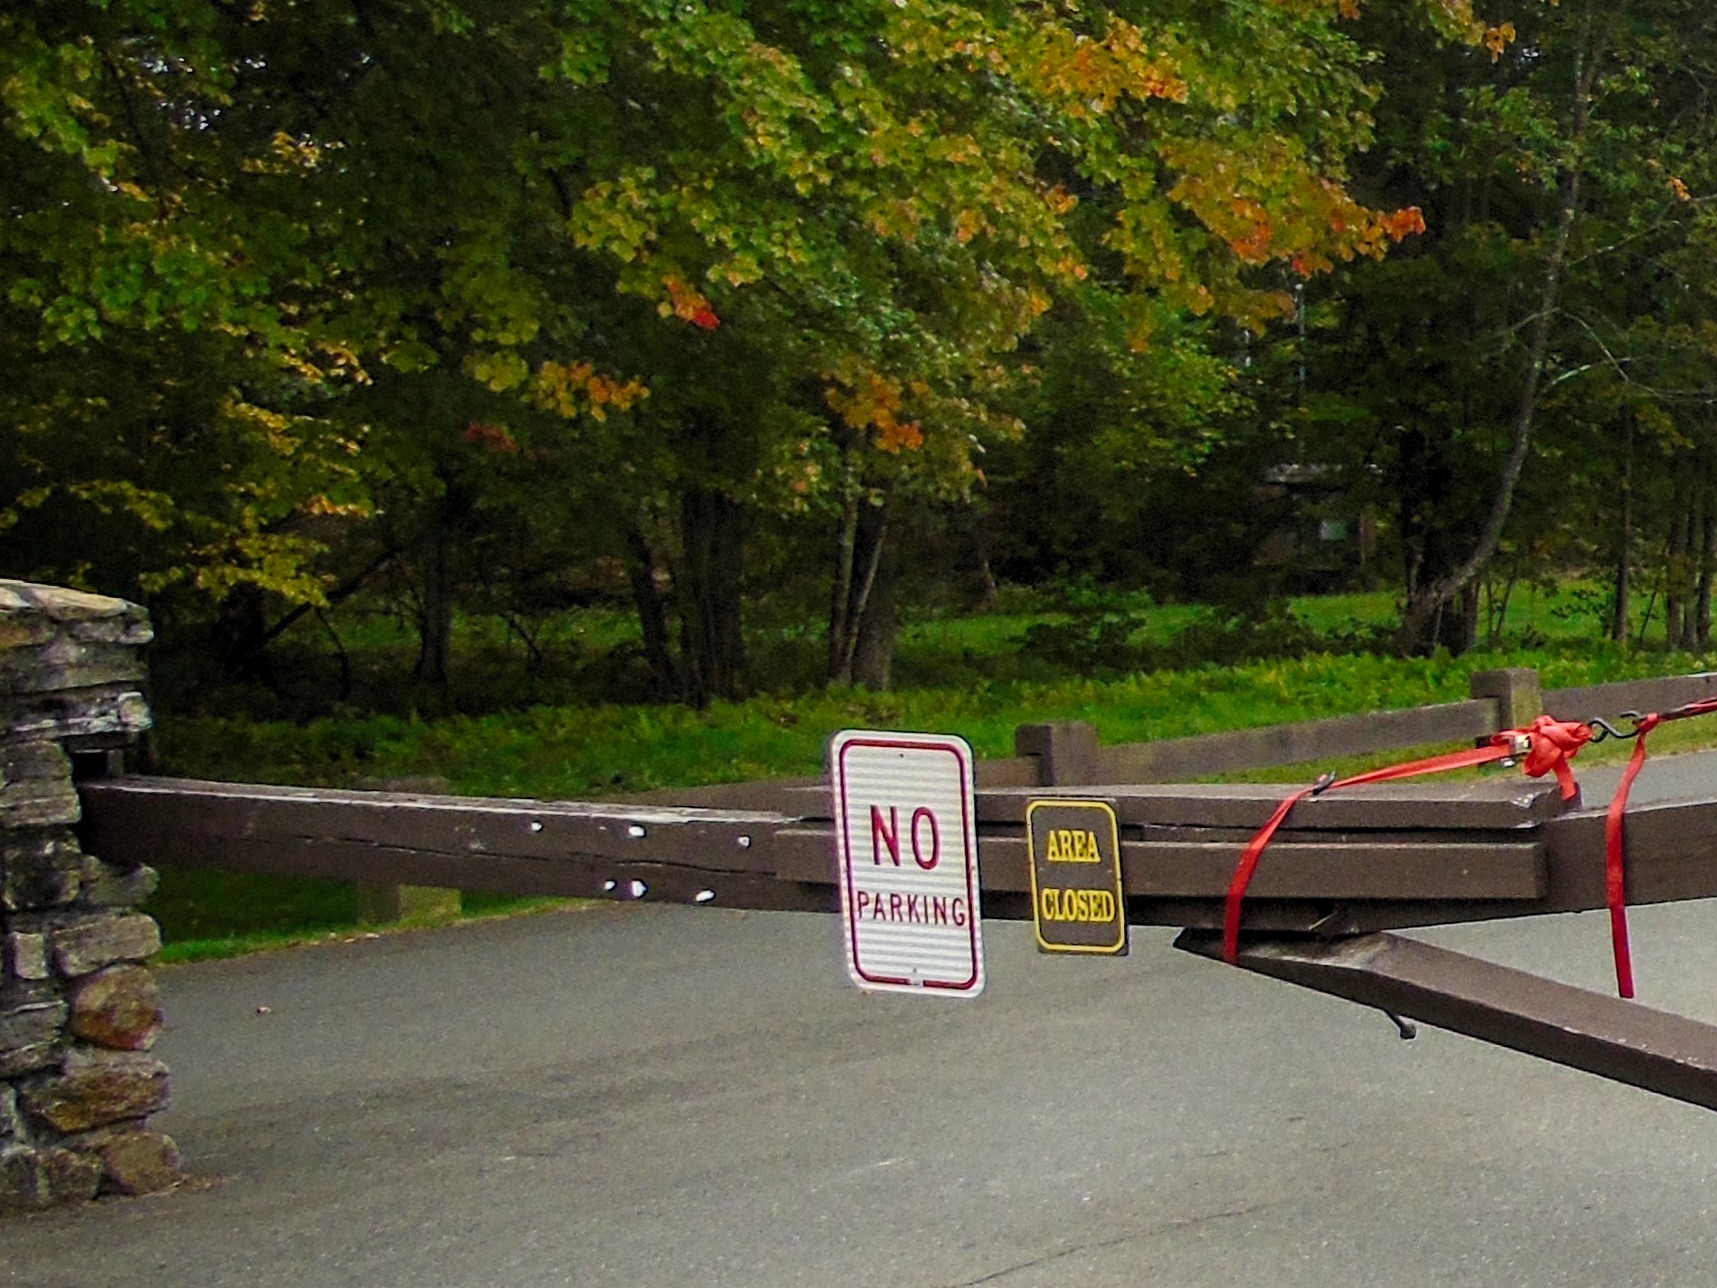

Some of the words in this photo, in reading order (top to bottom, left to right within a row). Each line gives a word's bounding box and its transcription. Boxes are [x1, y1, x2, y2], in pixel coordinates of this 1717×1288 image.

[870, 805, 941, 870] NO
[1047, 830, 1101, 863] AREA
[856, 890, 966, 926] PARKING
[1042, 888, 1115, 922] CLOSED
